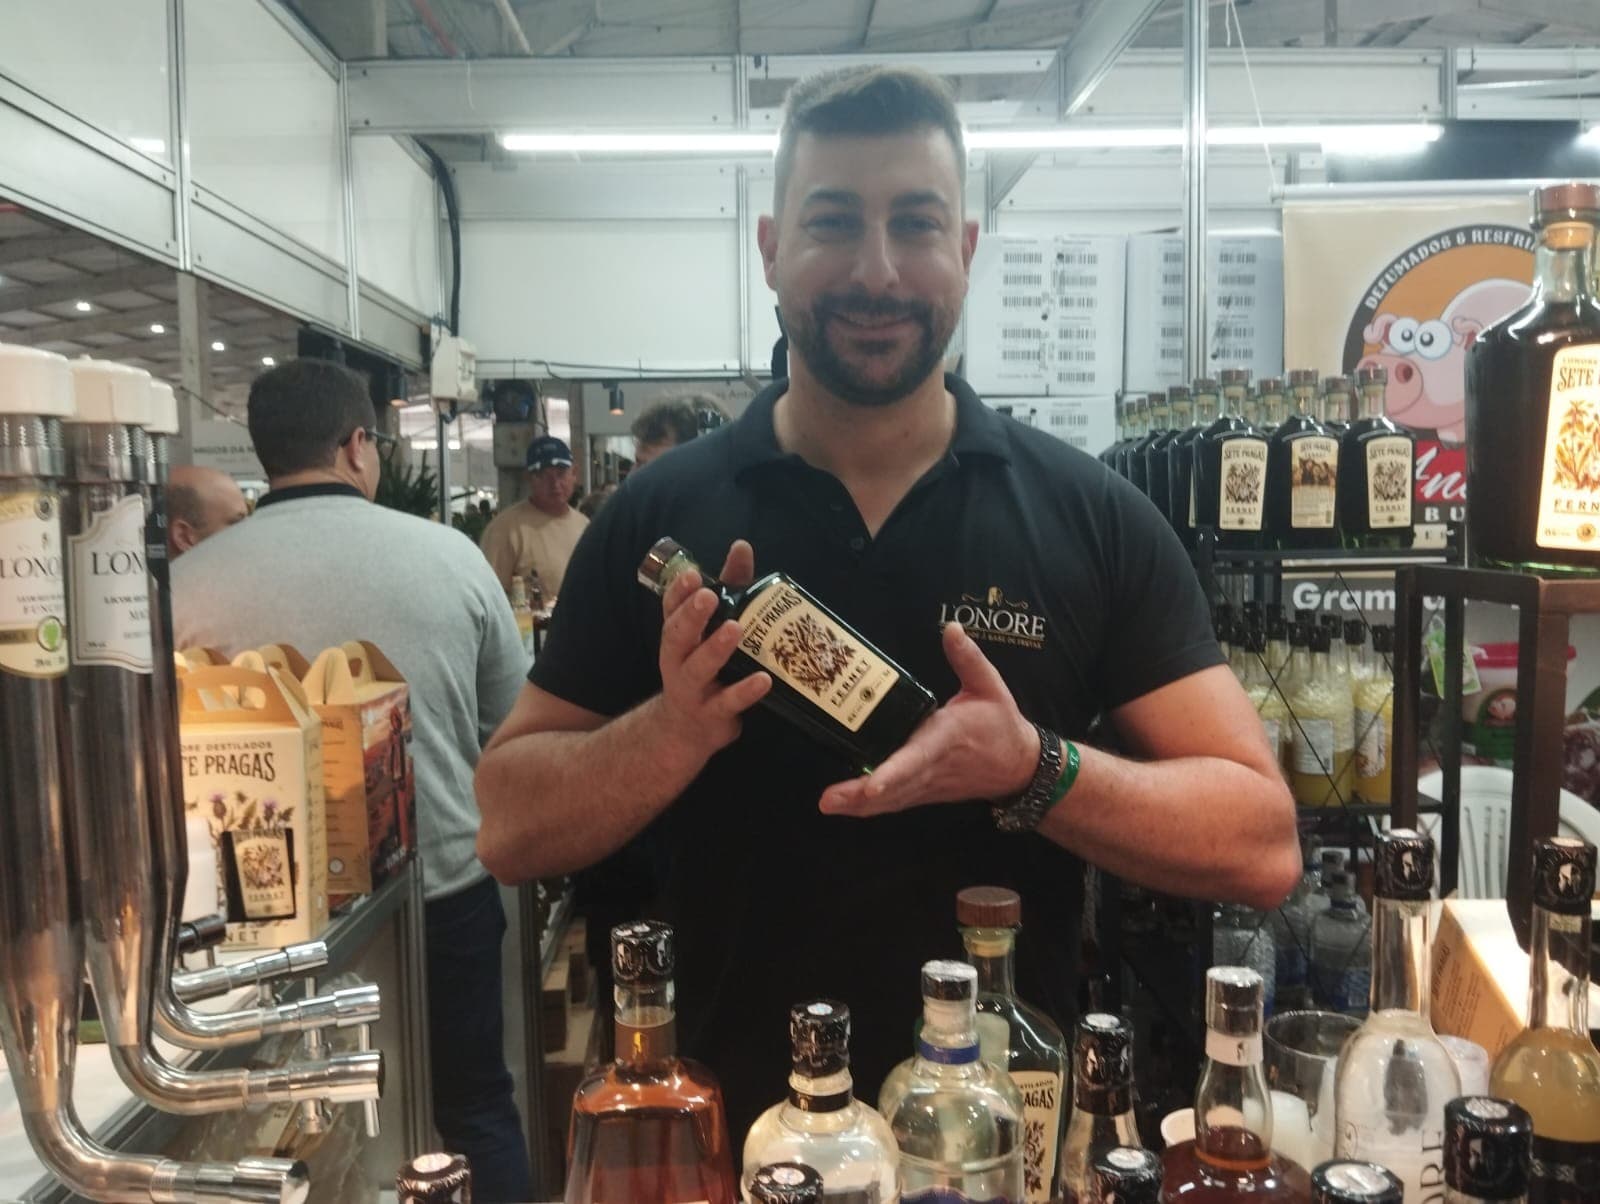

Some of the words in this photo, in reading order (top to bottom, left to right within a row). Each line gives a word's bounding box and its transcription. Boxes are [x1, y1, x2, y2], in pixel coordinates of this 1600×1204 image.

[1365, 235, 1451, 310] DEFUMADOS
[1557, 366, 1594, 392] SETE
[743, 623, 768, 656] SETE
[762, 590, 802, 628] PRAGAS
[205, 752, 276, 782] PRAGAS
